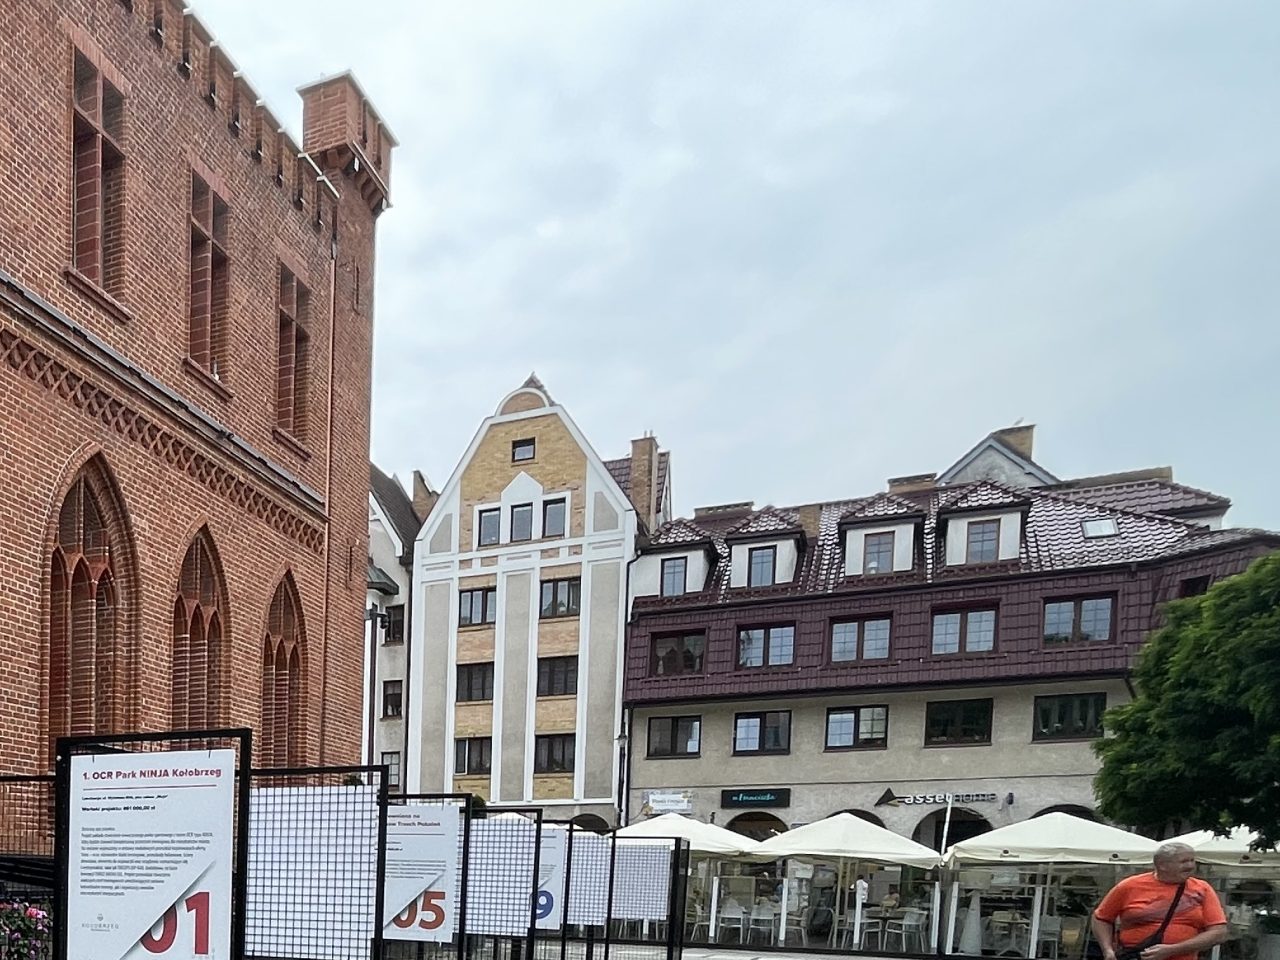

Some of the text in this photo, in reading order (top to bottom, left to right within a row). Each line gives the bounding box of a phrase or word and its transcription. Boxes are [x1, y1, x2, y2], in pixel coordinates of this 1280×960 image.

[82, 768, 222, 780] 1. OCR Park NINJA Kołobrzeg
[139, 891, 210, 955] 01
[391, 890, 446, 930] 05
